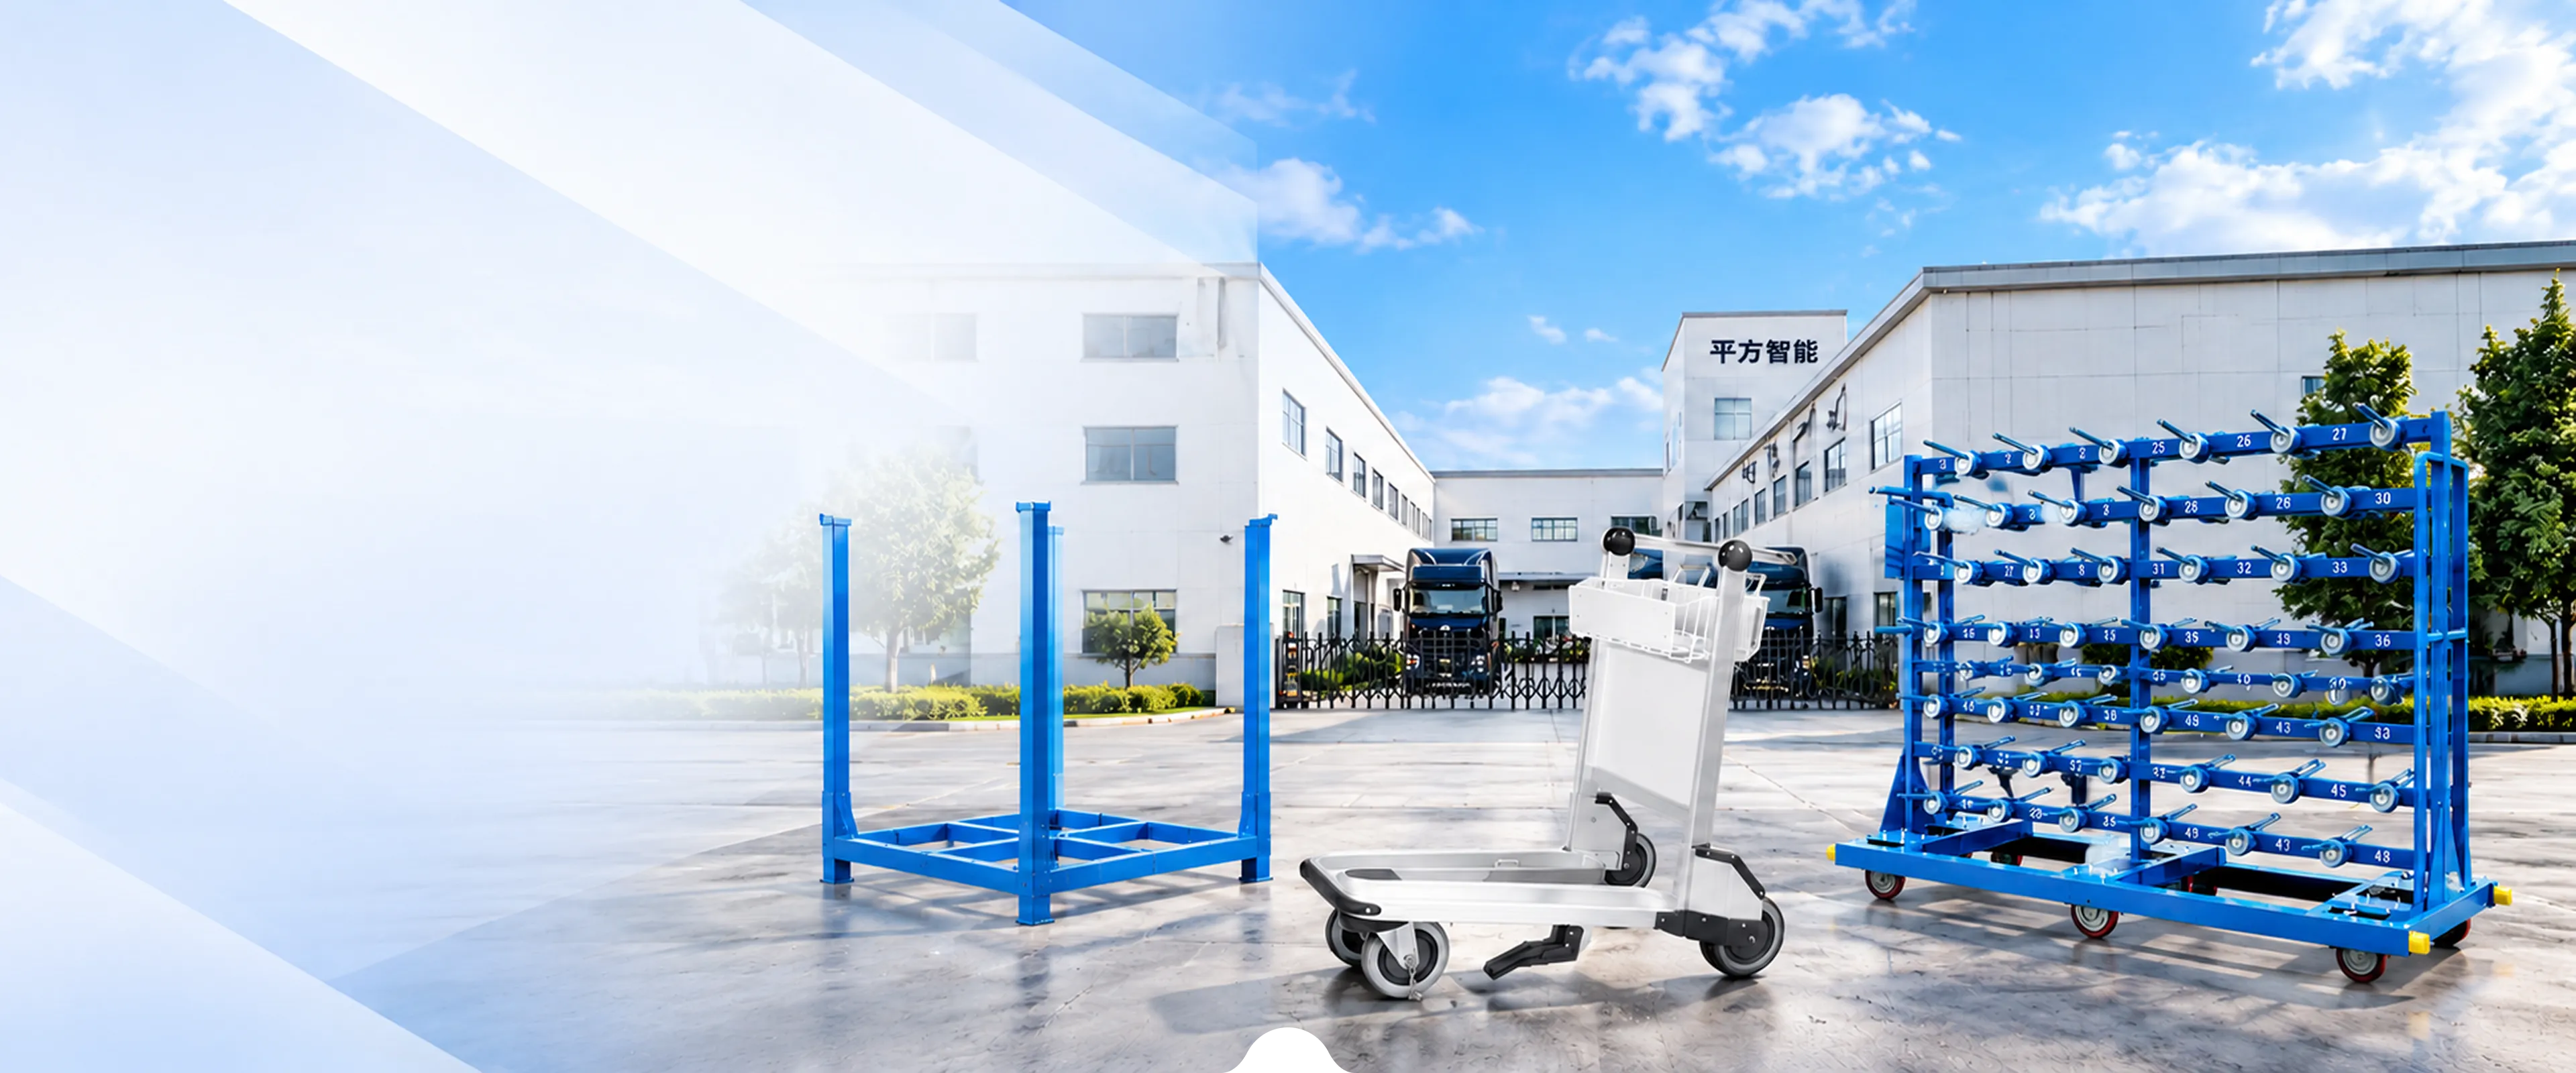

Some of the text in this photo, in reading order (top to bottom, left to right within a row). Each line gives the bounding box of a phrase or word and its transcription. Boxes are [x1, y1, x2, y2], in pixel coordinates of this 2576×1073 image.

[1710, 339, 1819, 364] 平方智能
[2237, 434, 2251, 447] 26
[2332, 427, 2347, 441] 27
[2152, 441, 2165, 454] 25
[2375, 492, 2391, 504] 30
[2153, 563, 2164, 575] 31
[2237, 562, 2251, 574] 32
[2332, 561, 2347, 573] 33
[2375, 634, 2391, 646] 36
[2330, 783, 2347, 797] 45
[2275, 838, 2290, 851] 43
[2375, 850, 2390, 863] 48
